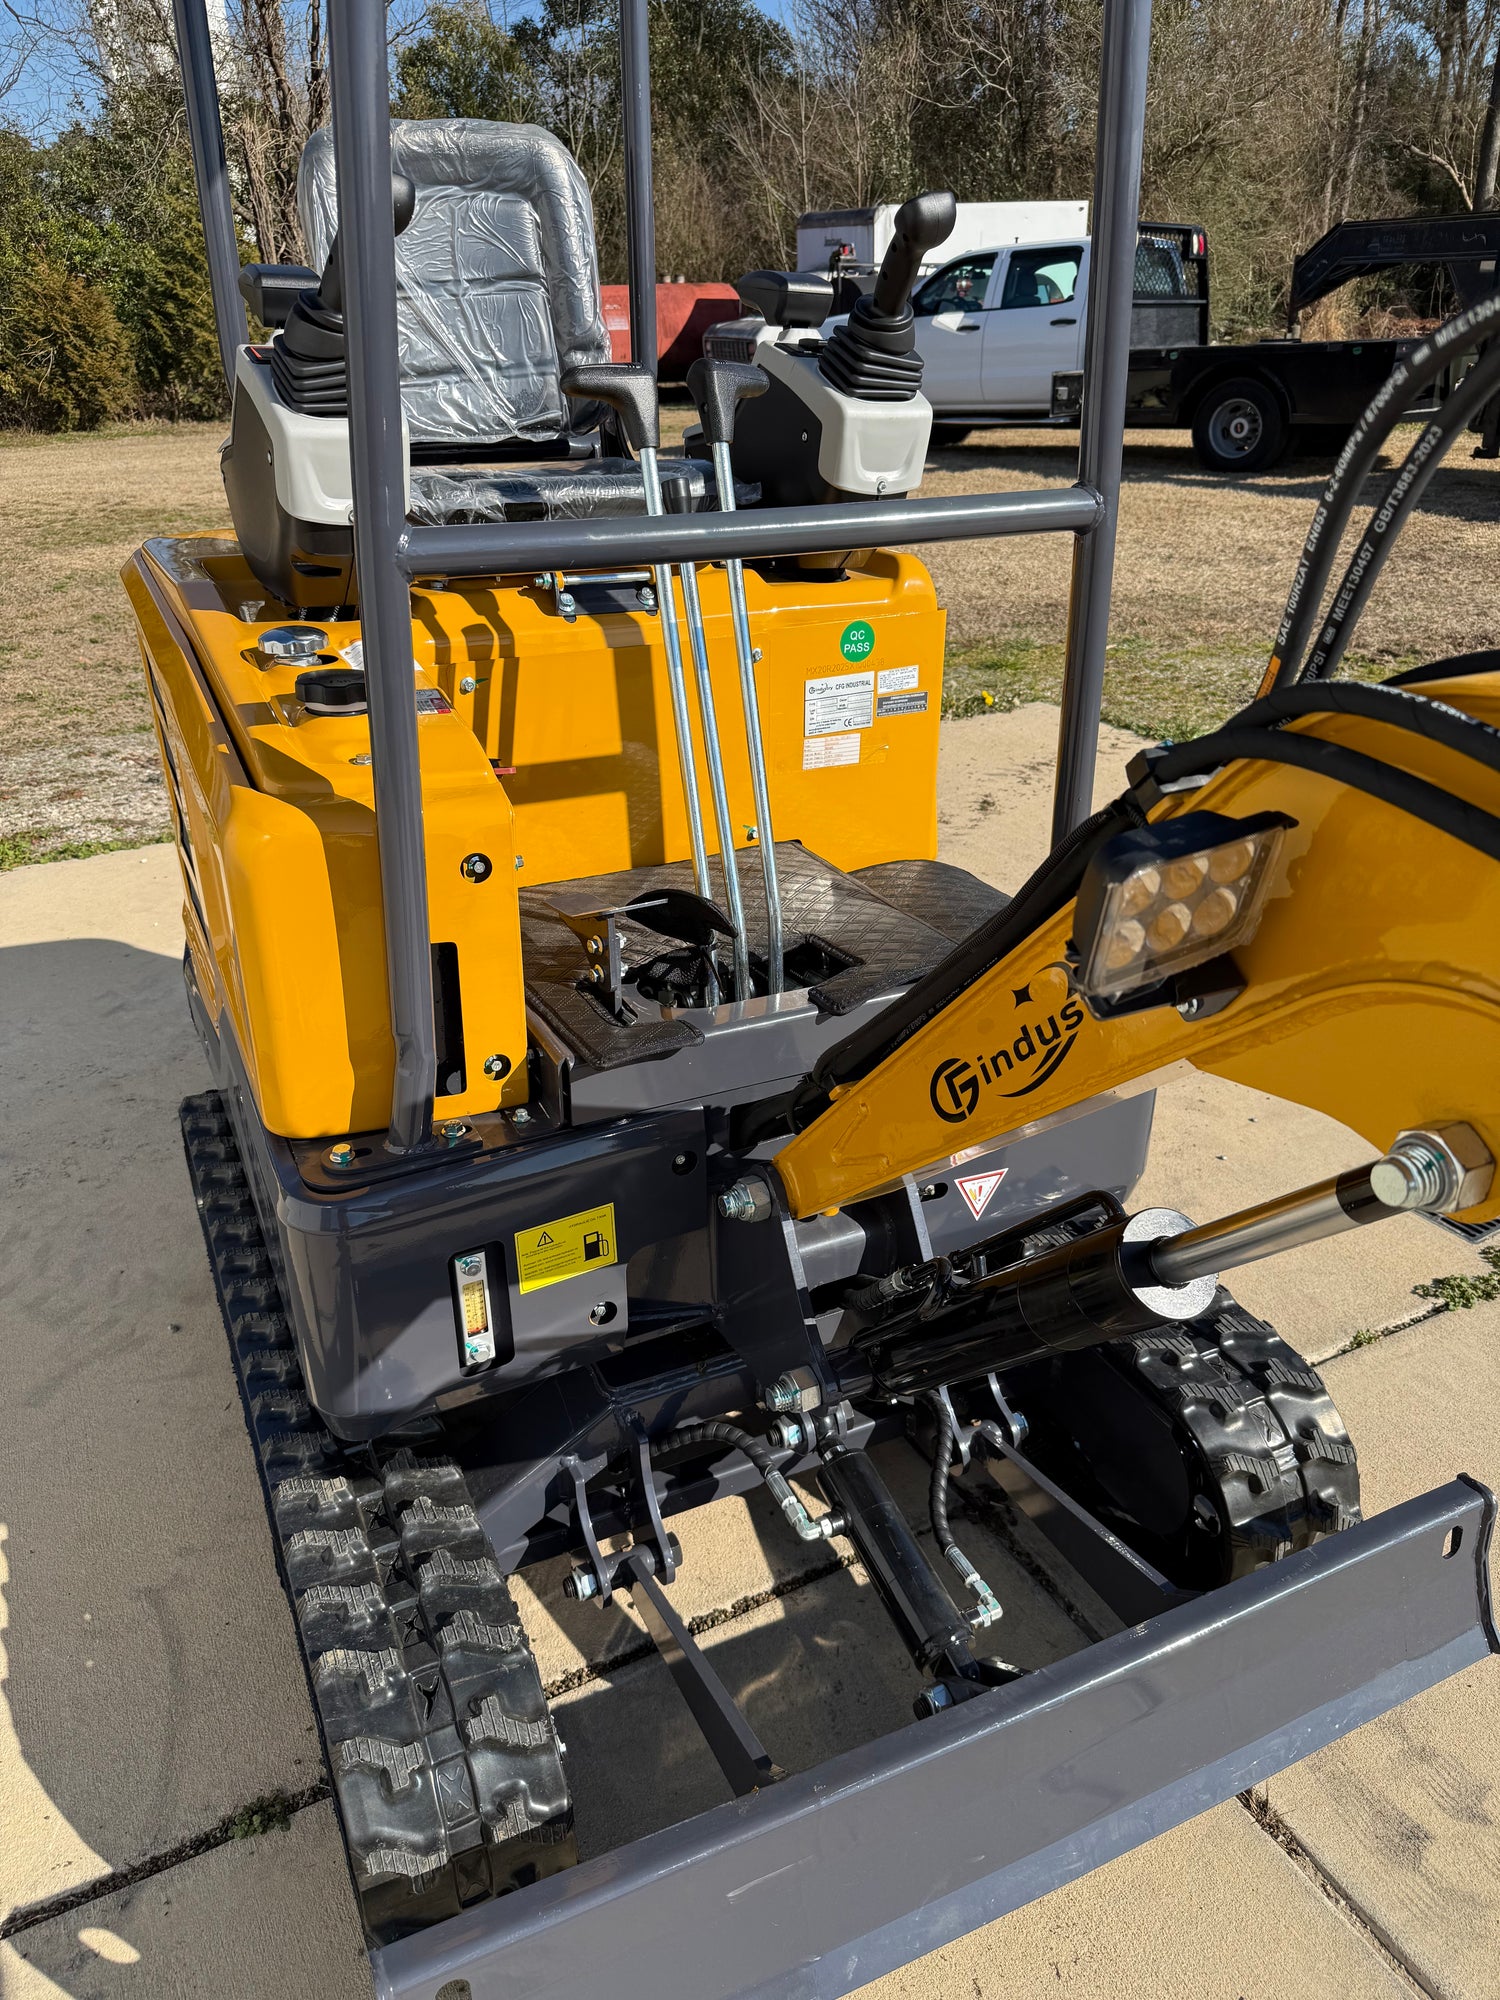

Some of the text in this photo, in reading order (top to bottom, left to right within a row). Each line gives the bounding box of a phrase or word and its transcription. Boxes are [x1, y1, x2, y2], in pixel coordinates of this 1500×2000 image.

[1332, 542, 1375, 622] MEE130457
[1374, 425, 1443, 533] GB/T3683-2023
[1277, 619, 1292, 646] SAE
[1306, 507, 1328, 552] EN853
[850, 629, 865, 641] QC
[843, 641, 870, 654] PASS
[846, 680, 871, 689] INDUSTRIAL
